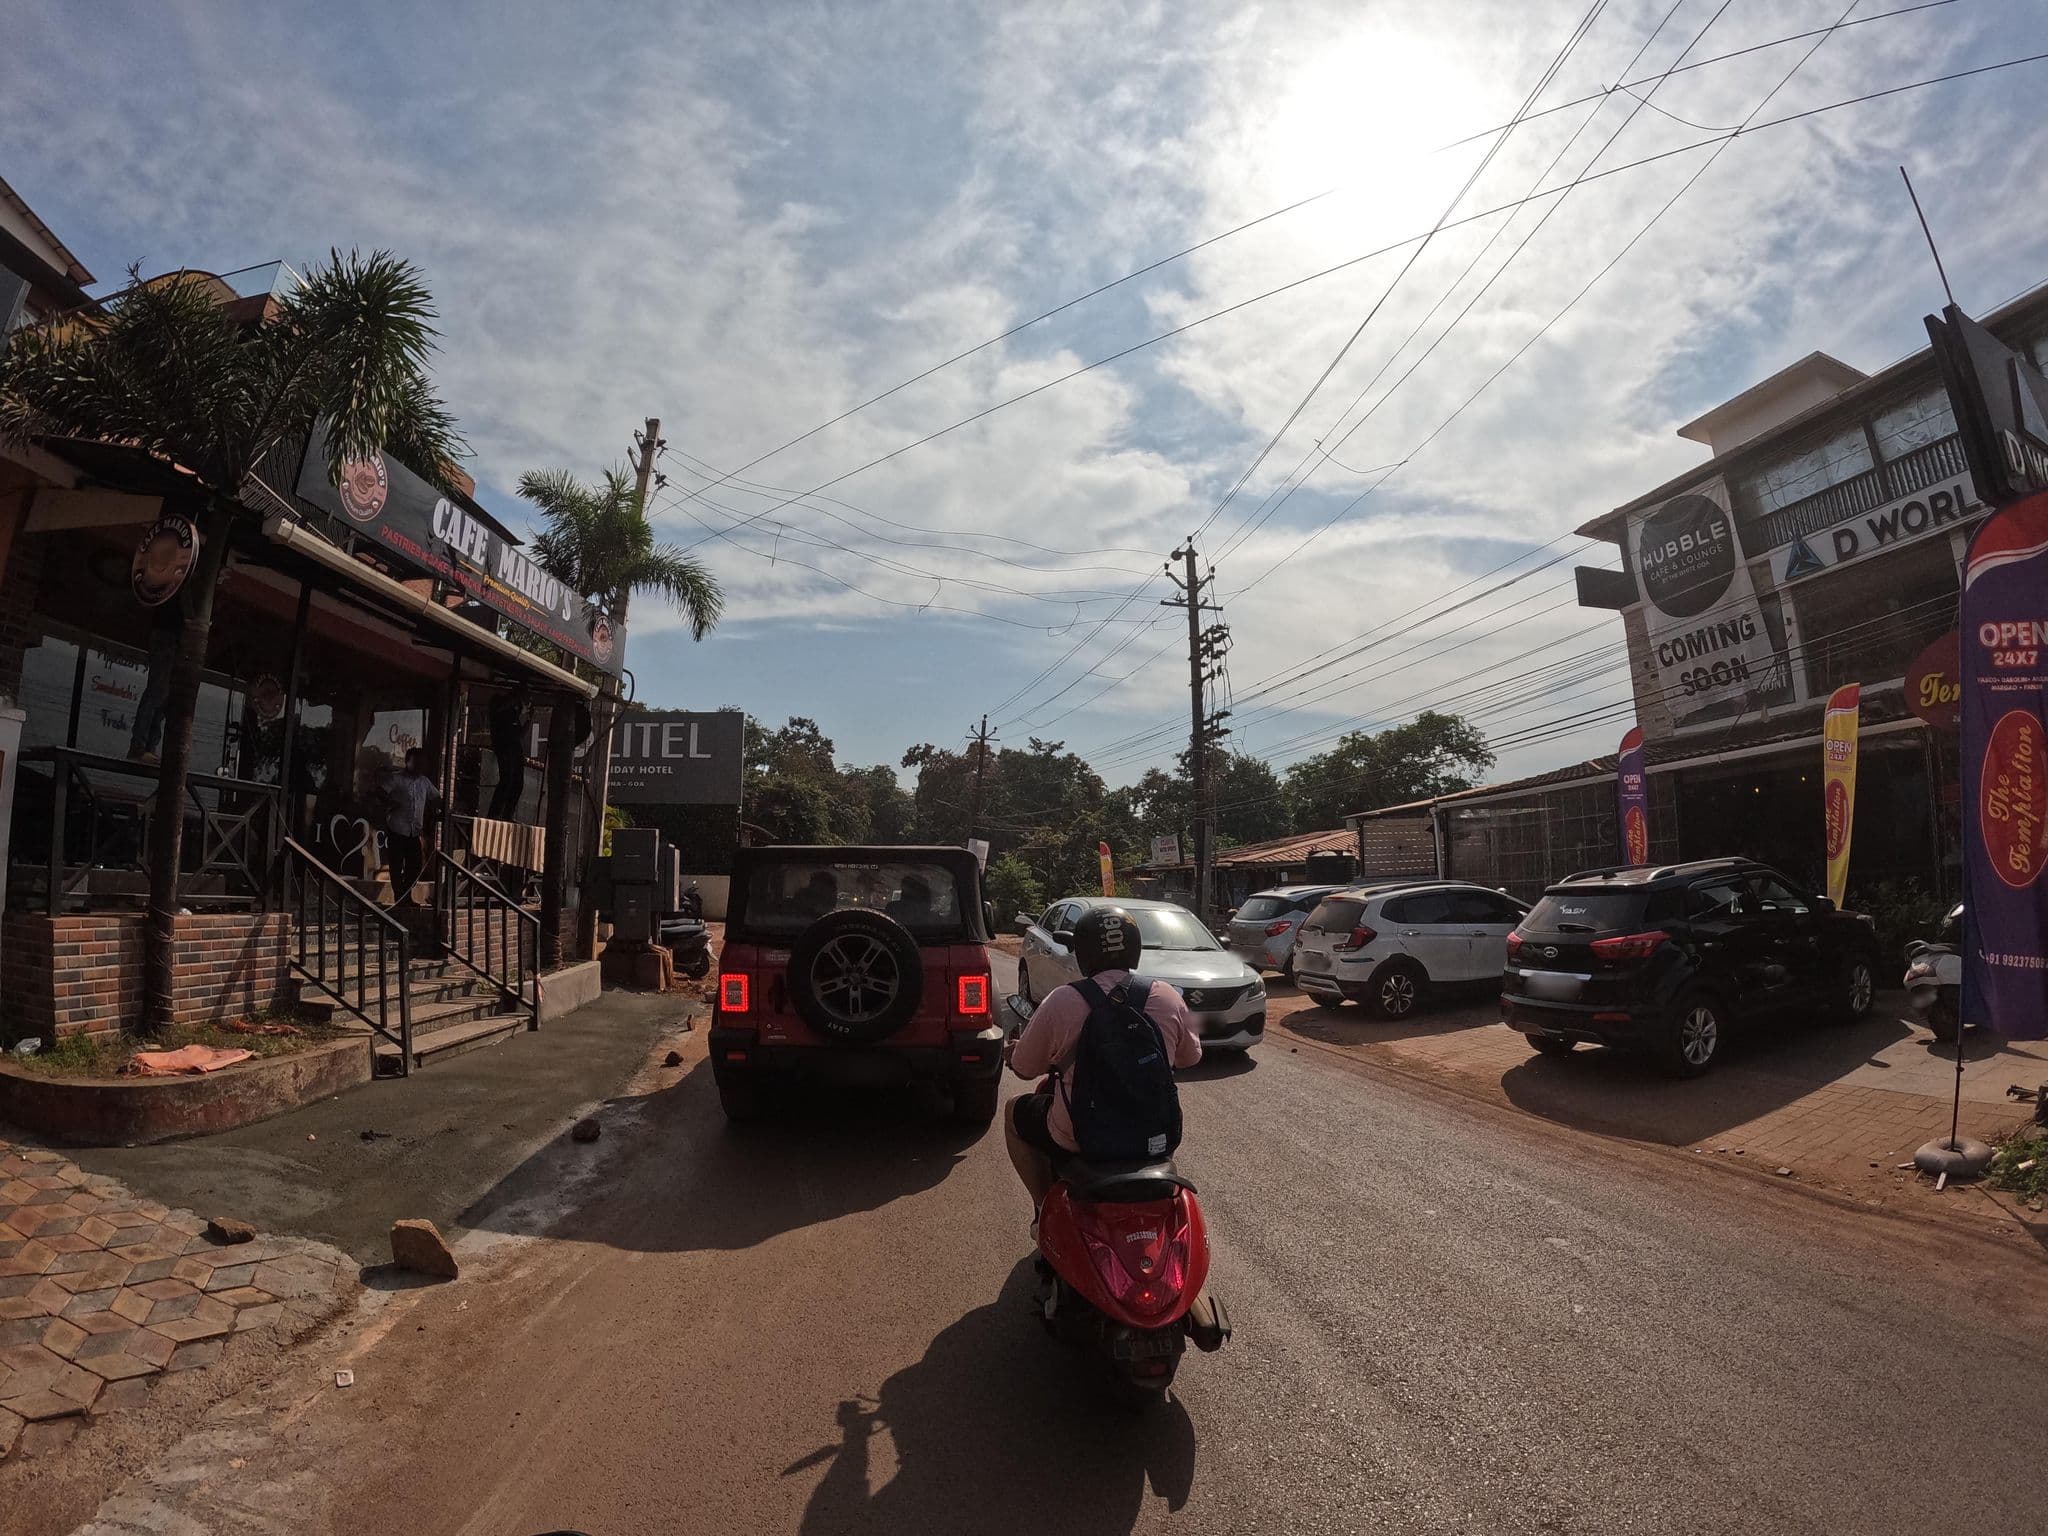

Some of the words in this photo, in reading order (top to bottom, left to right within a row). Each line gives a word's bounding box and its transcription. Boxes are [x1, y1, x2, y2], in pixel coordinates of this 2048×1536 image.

[163, 517, 191, 548] MARIO'S
[382, 525, 422, 558] PASTRIES
[1832, 529, 1859, 562] D
[1867, 484, 1982, 545] WORL
[433, 497, 489, 566] CAFE
[497, 542, 573, 622] MARIO'S
[1643, 520, 1727, 571] HUBBLE
[1672, 561, 1678, 570] &
[1681, 543, 1724, 567] LOUNGE
[483, 574, 511, 597] Premium
[510, 591, 531, 611] Quality
[1658, 613, 1757, 668] COMING
[1979, 621, 2048, 647] OPEN
[1680, 654, 1751, 697] SOON
[389, 723, 418, 753] Coffee
[530, 722, 712, 759] HITEL
[1826, 739, 1852, 753] OPEN
[639, 765, 674, 775] HOTEL
[1987, 773, 2011, 822] The
[2009, 723, 2041, 874] Temptation
